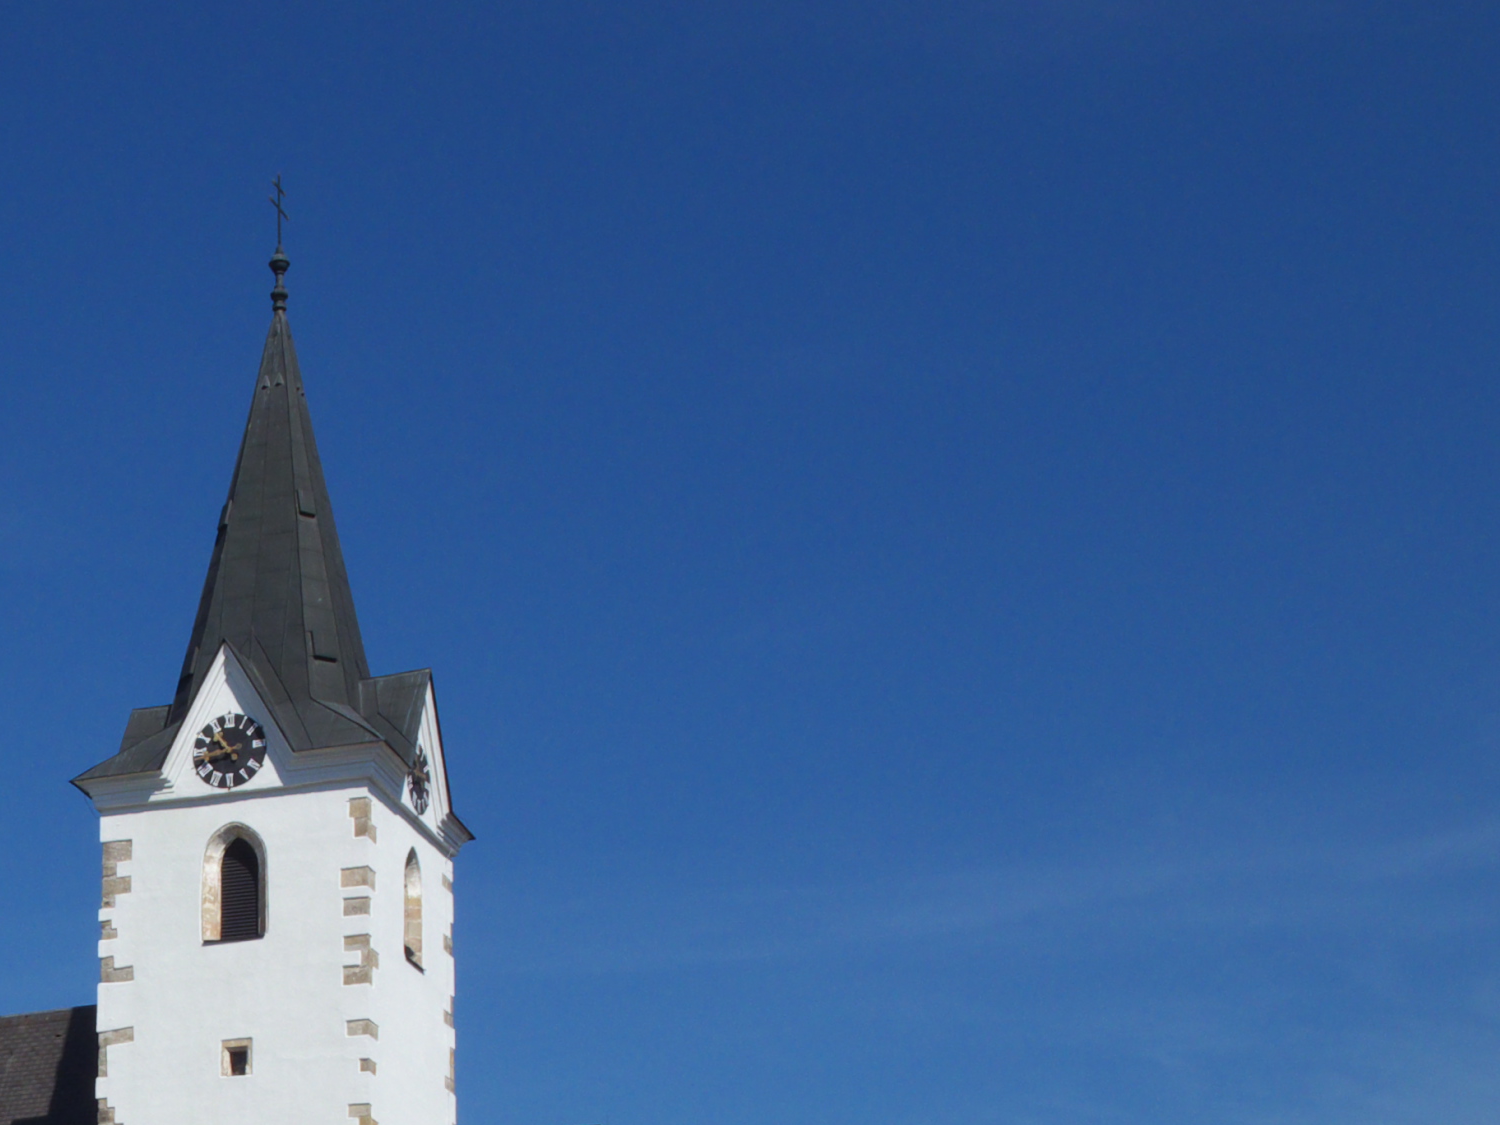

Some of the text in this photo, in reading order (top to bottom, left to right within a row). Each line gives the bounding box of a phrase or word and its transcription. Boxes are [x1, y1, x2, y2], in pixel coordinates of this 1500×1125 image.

[209, 719, 221, 734] XI
[224, 714, 235, 728] XII
[239, 715, 248, 729] I
[196, 731, 211, 744] X
[225, 773, 234, 787] VI
[239, 768, 249, 780] V
